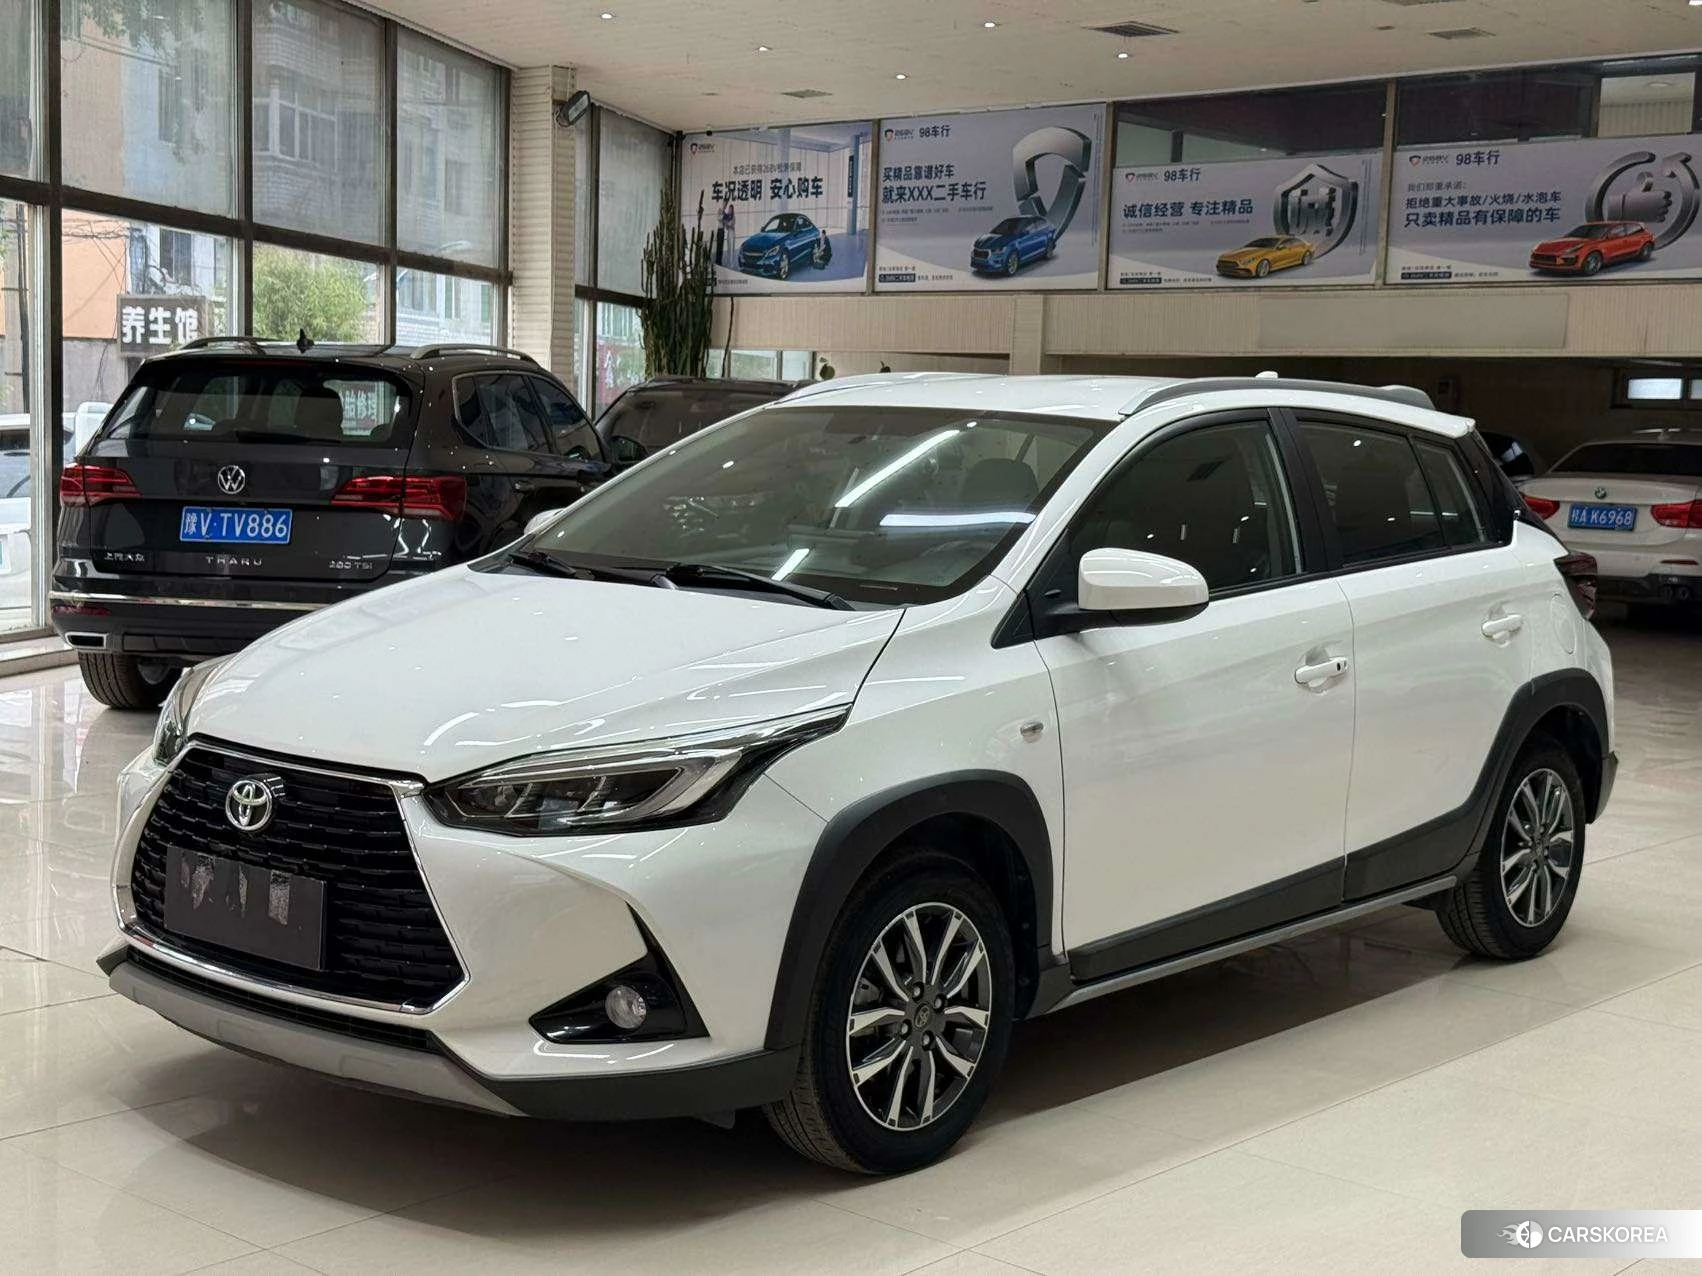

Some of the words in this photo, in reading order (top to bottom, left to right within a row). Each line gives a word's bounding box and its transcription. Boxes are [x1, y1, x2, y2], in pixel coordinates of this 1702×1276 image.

[919, 125, 951, 138] 98车行
[1455, 150, 1500, 166] 98车行
[882, 164, 955, 182] 买精品靠谱好车
[1163, 167, 1200, 183] 98车行
[711, 179, 762, 202] 车况透明
[770, 176, 824, 200] 安心购车
[882, 181, 987, 204] 就来XXX二手车行
[1123, 201, 1186, 219] 诚信经营
[1190, 199, 1254, 217] 专注精品
[1404, 207, 1561, 228] 只卖精品有保障的车
[122, 306, 199, 344] 养生馆
